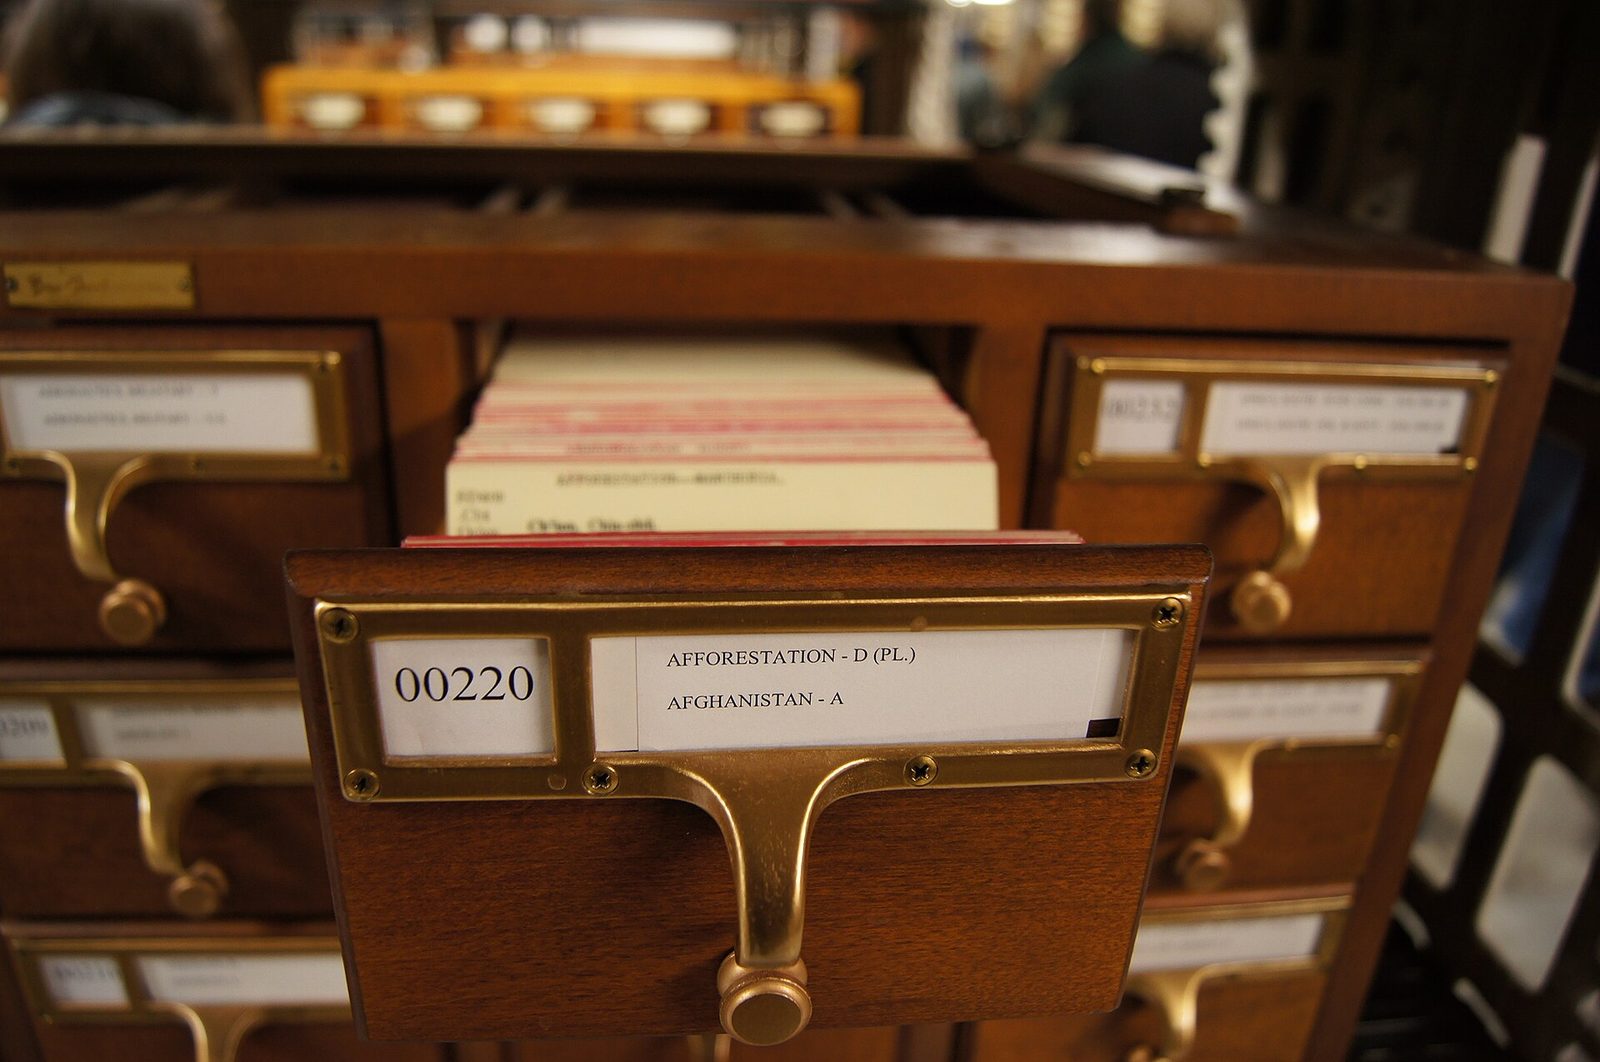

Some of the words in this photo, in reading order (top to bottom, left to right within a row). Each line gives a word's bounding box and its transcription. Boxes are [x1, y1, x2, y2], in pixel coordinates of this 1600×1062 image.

[667, 648, 836, 669] AFFORESTATION
[854, 648, 868, 663] D
[873, 647, 917, 667] (PL.)
[394, 664, 535, 703] 00220
[667, 692, 812, 711] AFGHANISTAN
[829, 692, 844, 706] A
